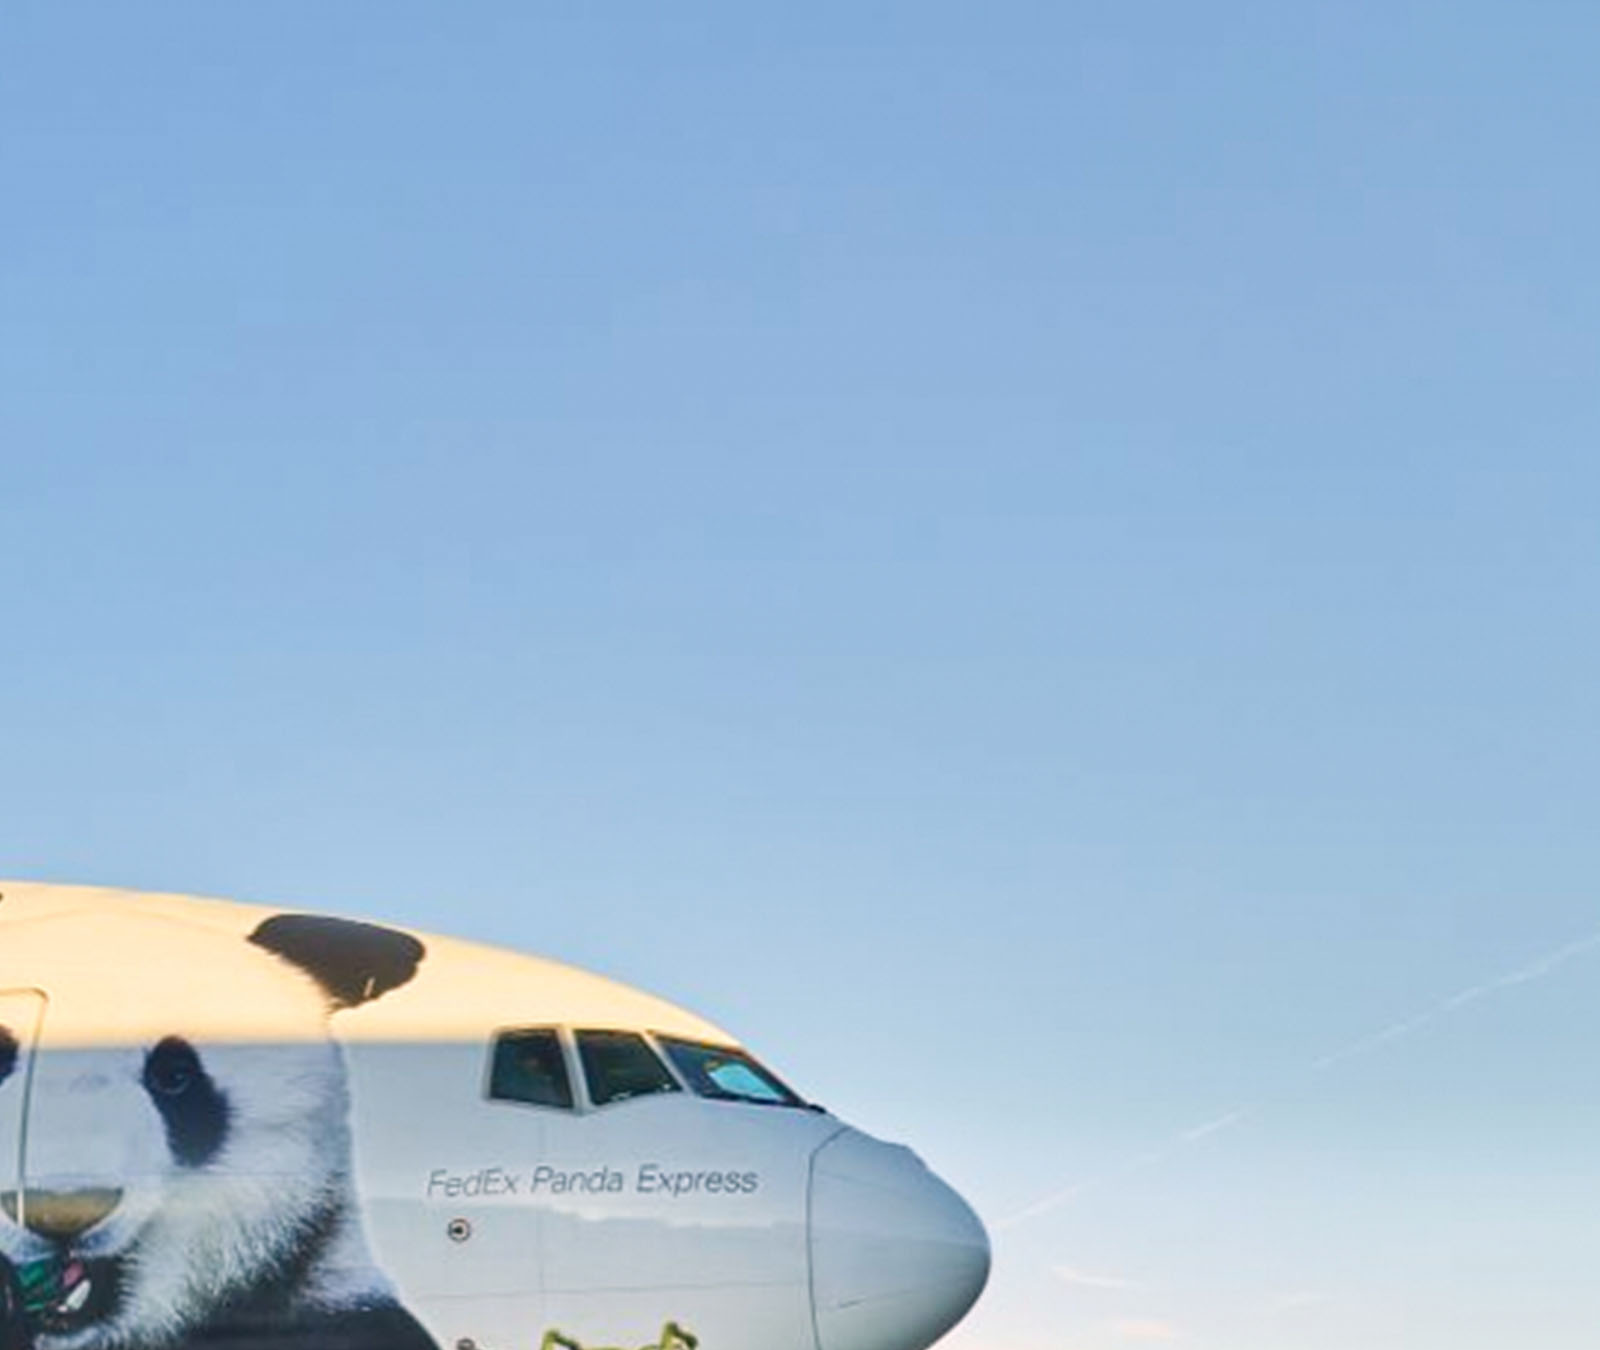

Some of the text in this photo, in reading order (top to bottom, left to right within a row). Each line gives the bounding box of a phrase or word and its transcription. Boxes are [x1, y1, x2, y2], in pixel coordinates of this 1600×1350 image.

[427, 1163, 760, 1198] FedEx Panda Express
